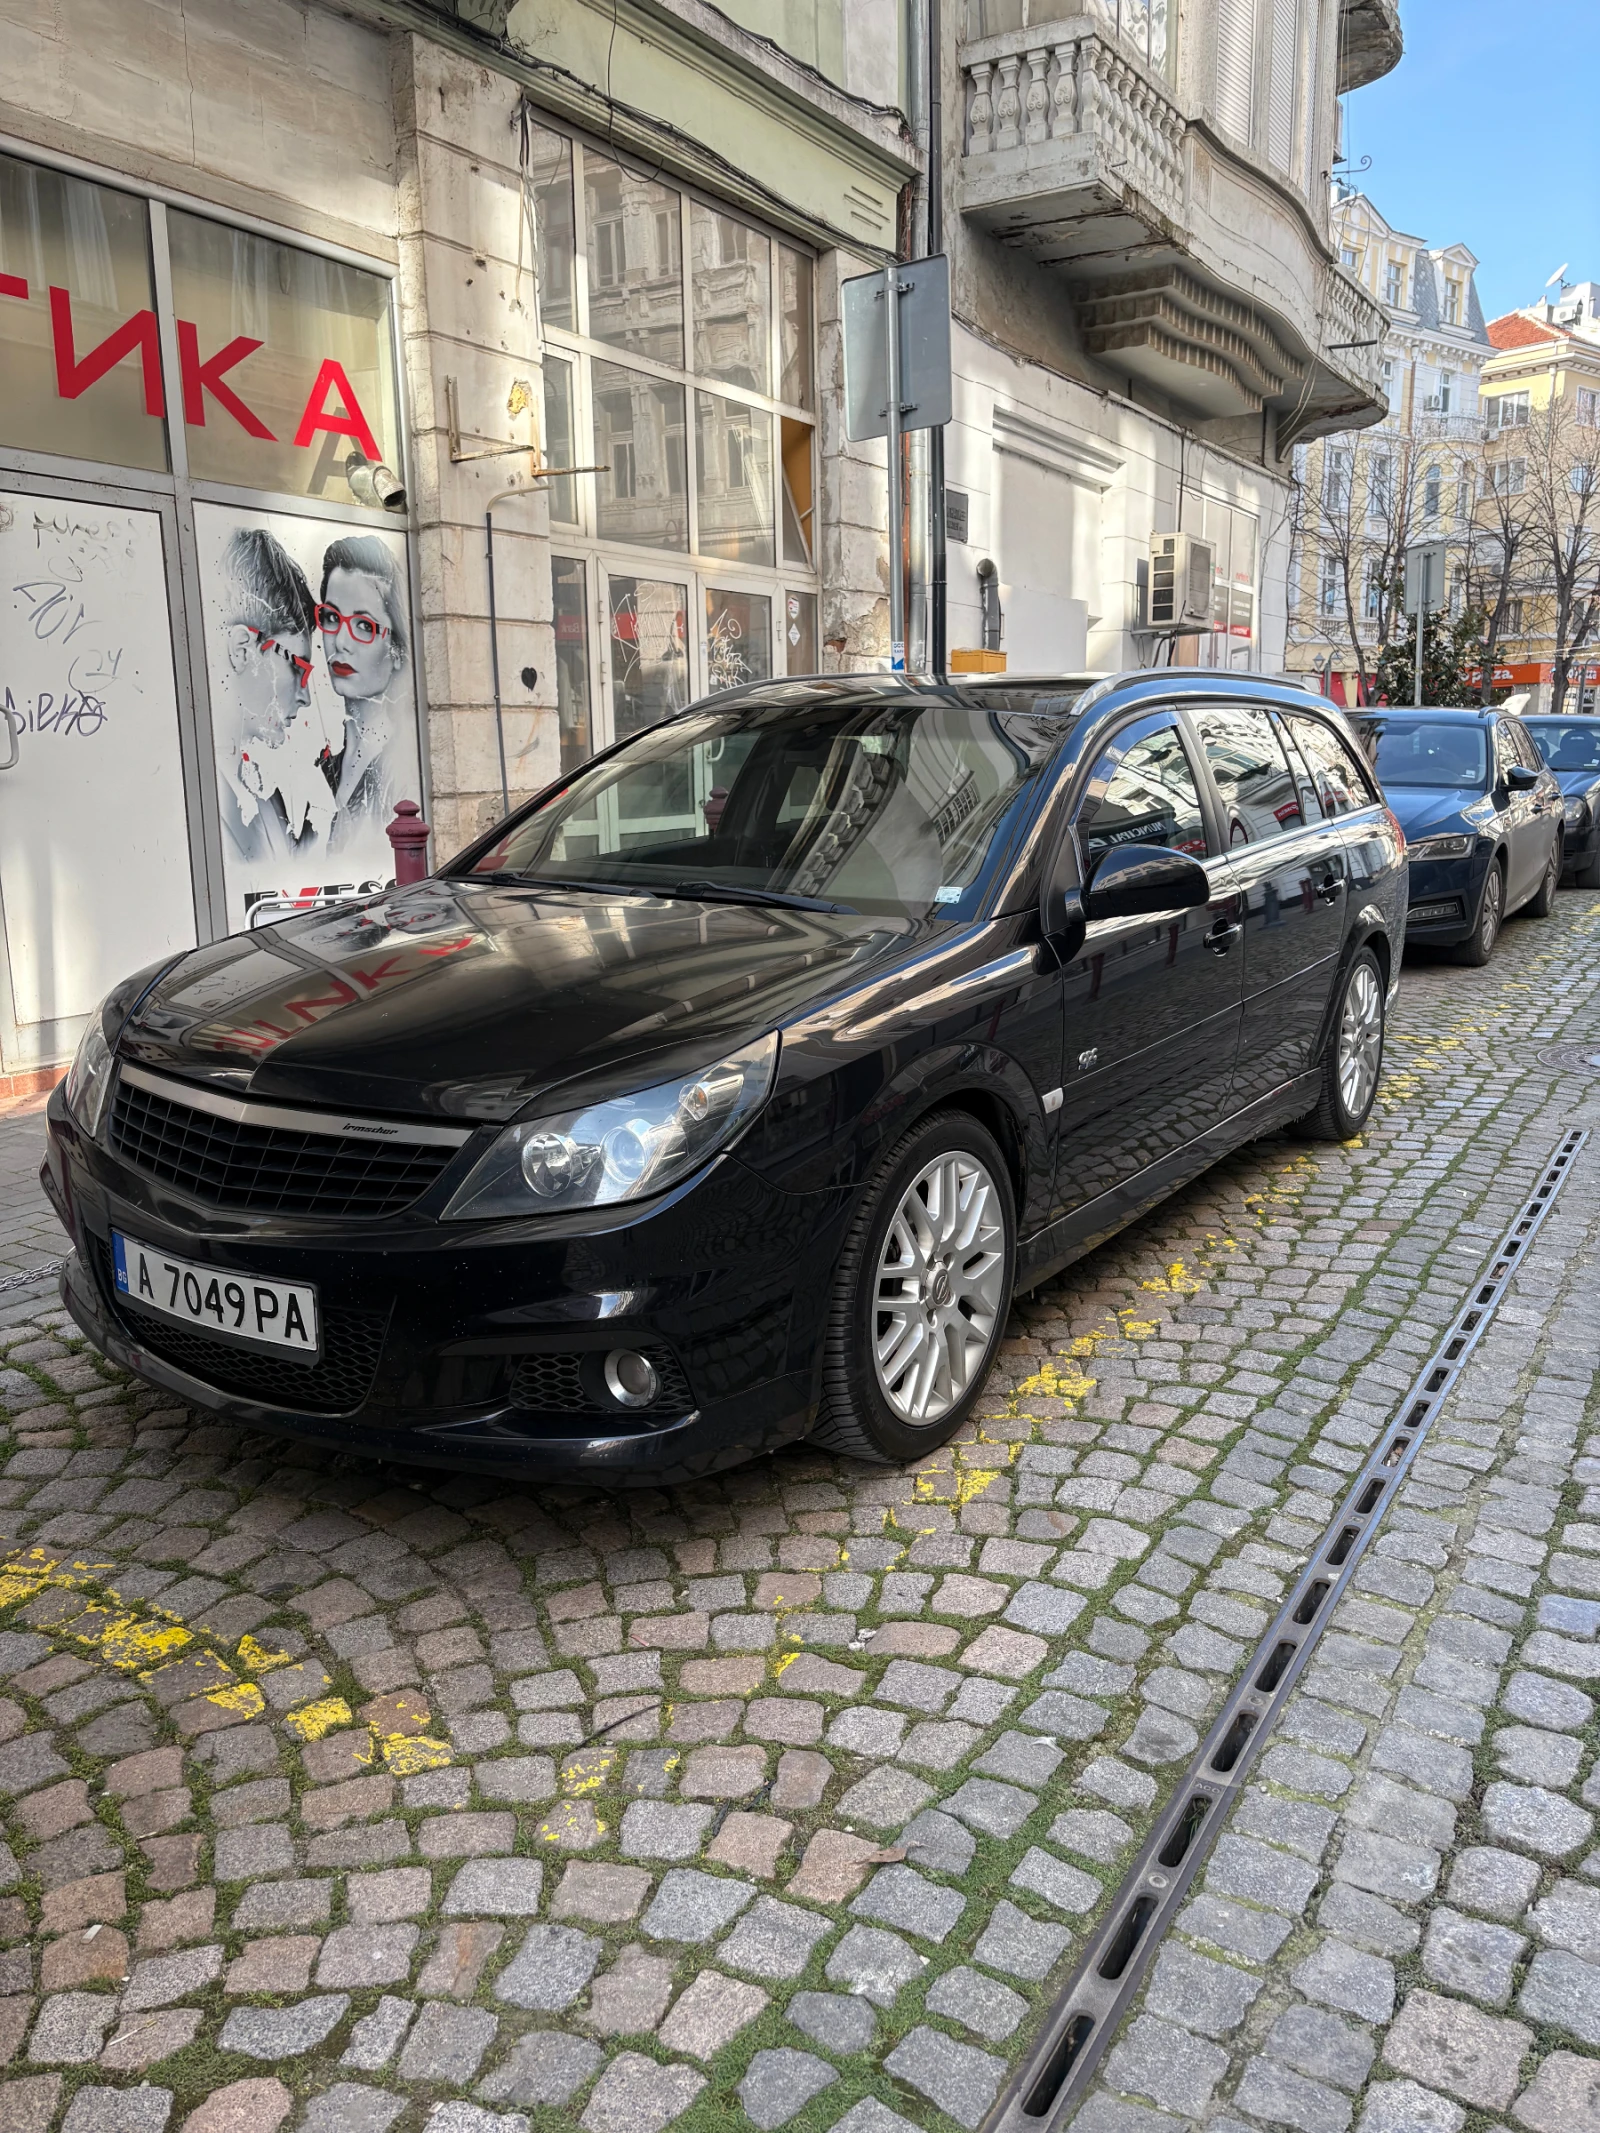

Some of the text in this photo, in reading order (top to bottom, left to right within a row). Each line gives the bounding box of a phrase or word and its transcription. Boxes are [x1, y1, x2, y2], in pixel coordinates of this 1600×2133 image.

[342, 1122, 399, 1136] irmscher
[117, 1267, 128, 1285] BG
[163, 1262, 245, 1328] 7049
